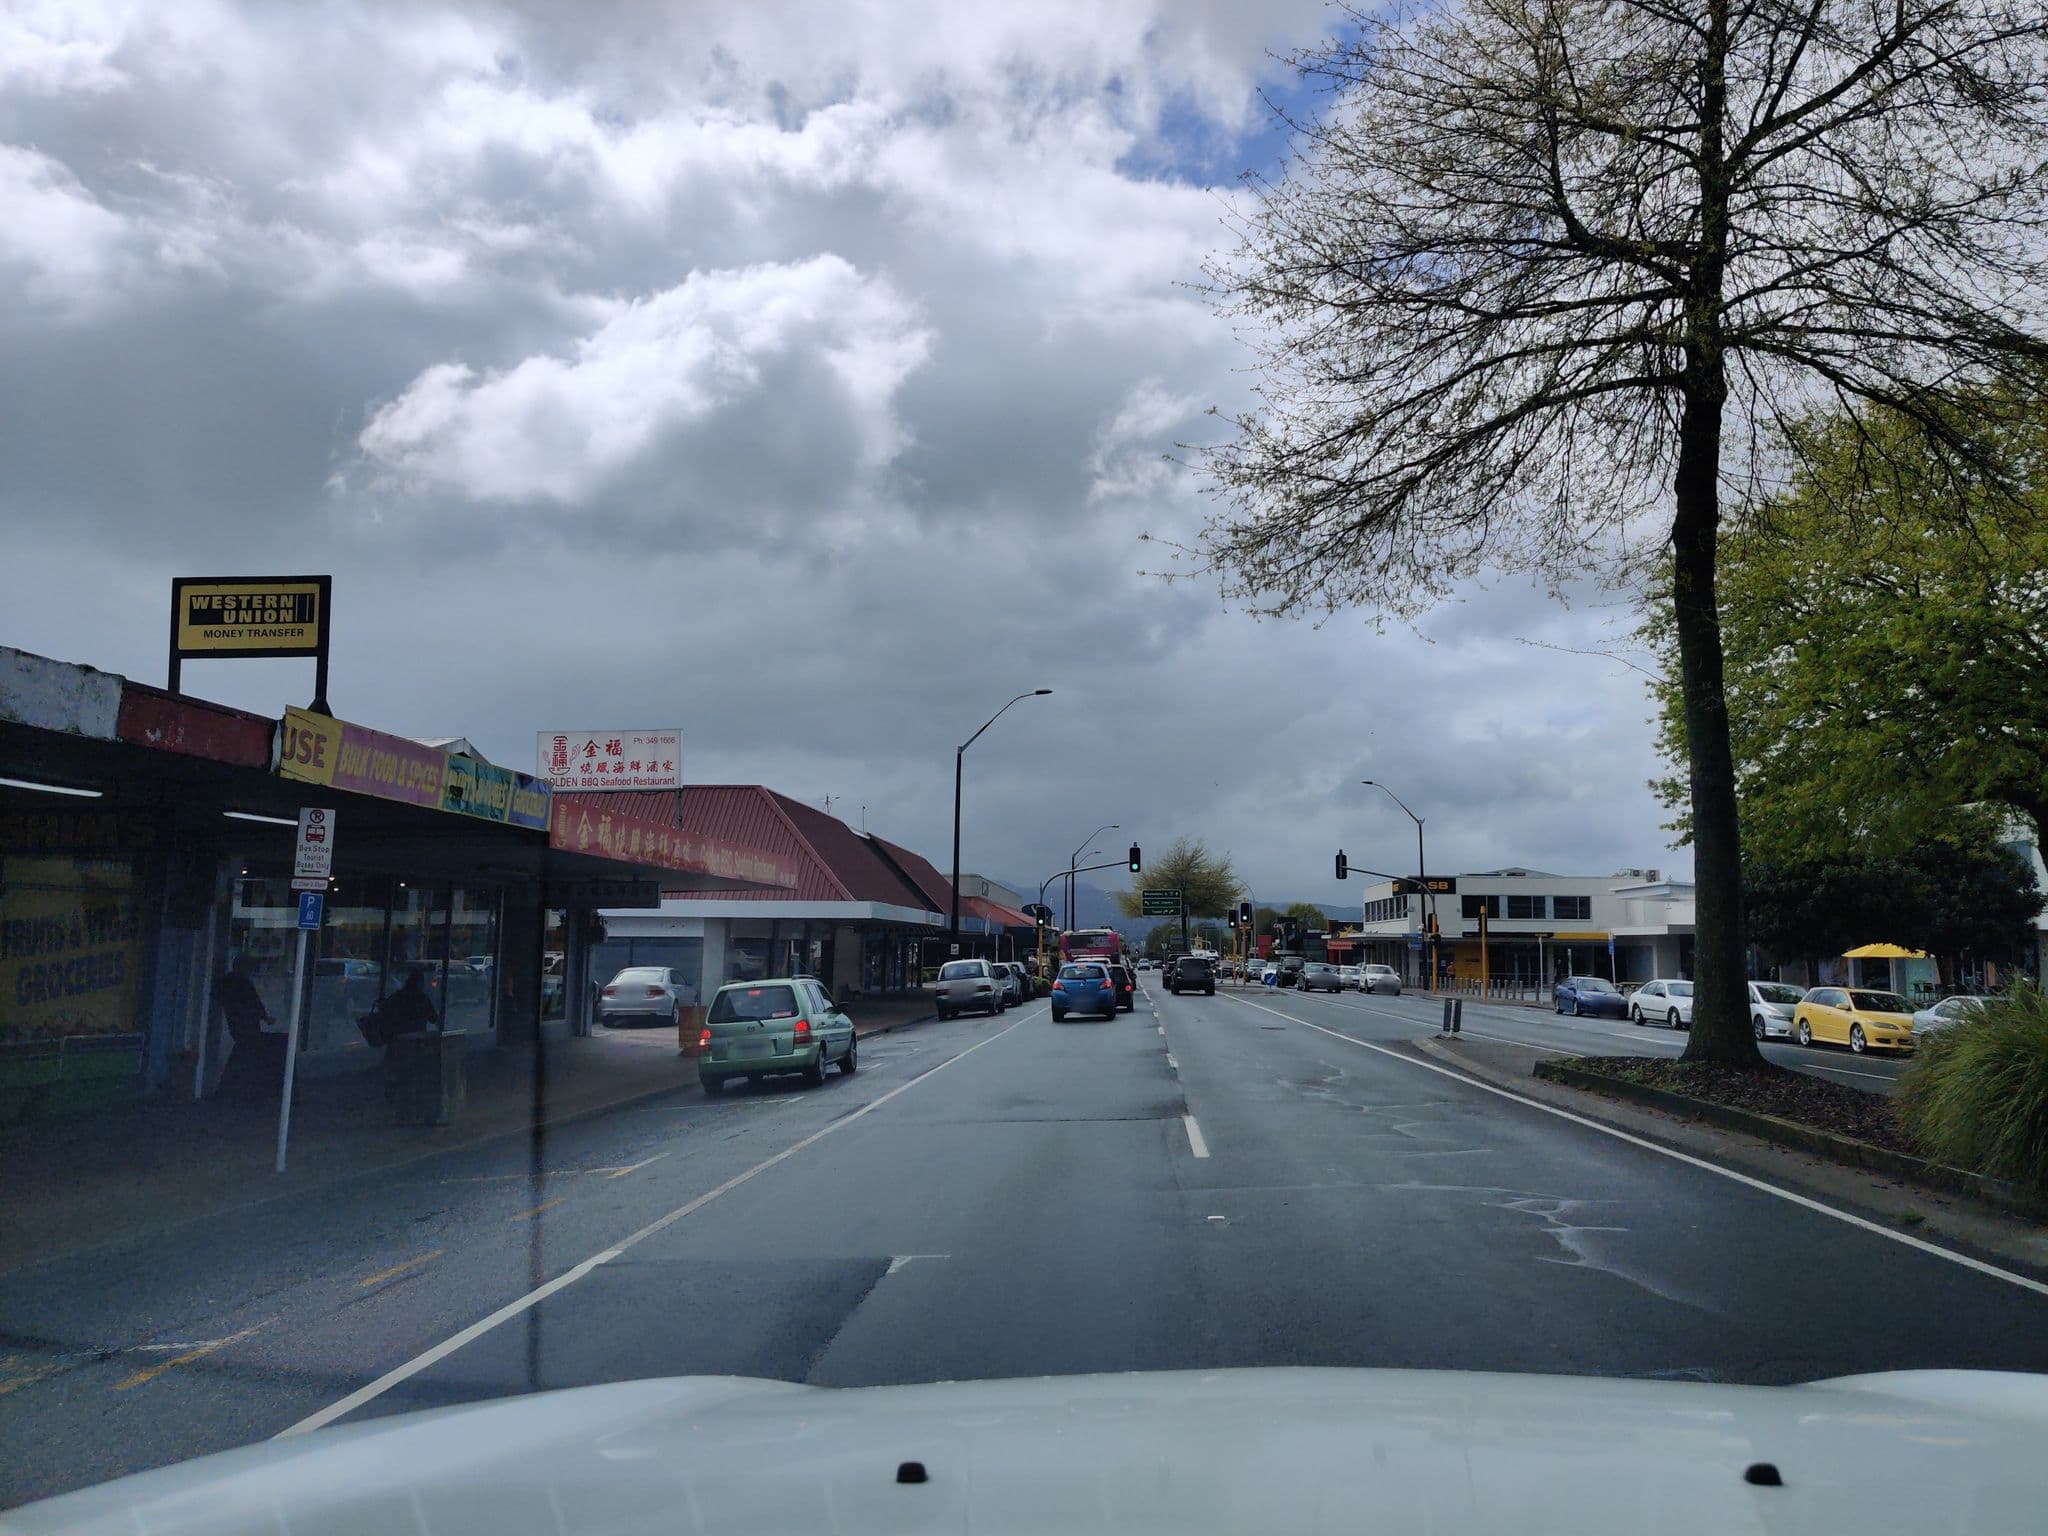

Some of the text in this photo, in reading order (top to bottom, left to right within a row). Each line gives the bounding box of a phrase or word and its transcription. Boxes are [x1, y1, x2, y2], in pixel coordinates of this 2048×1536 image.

[191, 594, 294, 610] WESTERN
[223, 609, 293, 624] UNION
[203, 627, 304, 639] MONEY TRANSFER
[582, 739, 623, 758] 金福
[581, 777, 599, 787] BBQ
[601, 776, 632, 786] Seafood
[634, 776, 675, 786] Restaurant
[313, 845, 330, 854] Stop
[303, 853, 324, 862] Tourist
[307, 896, 315, 906] P
